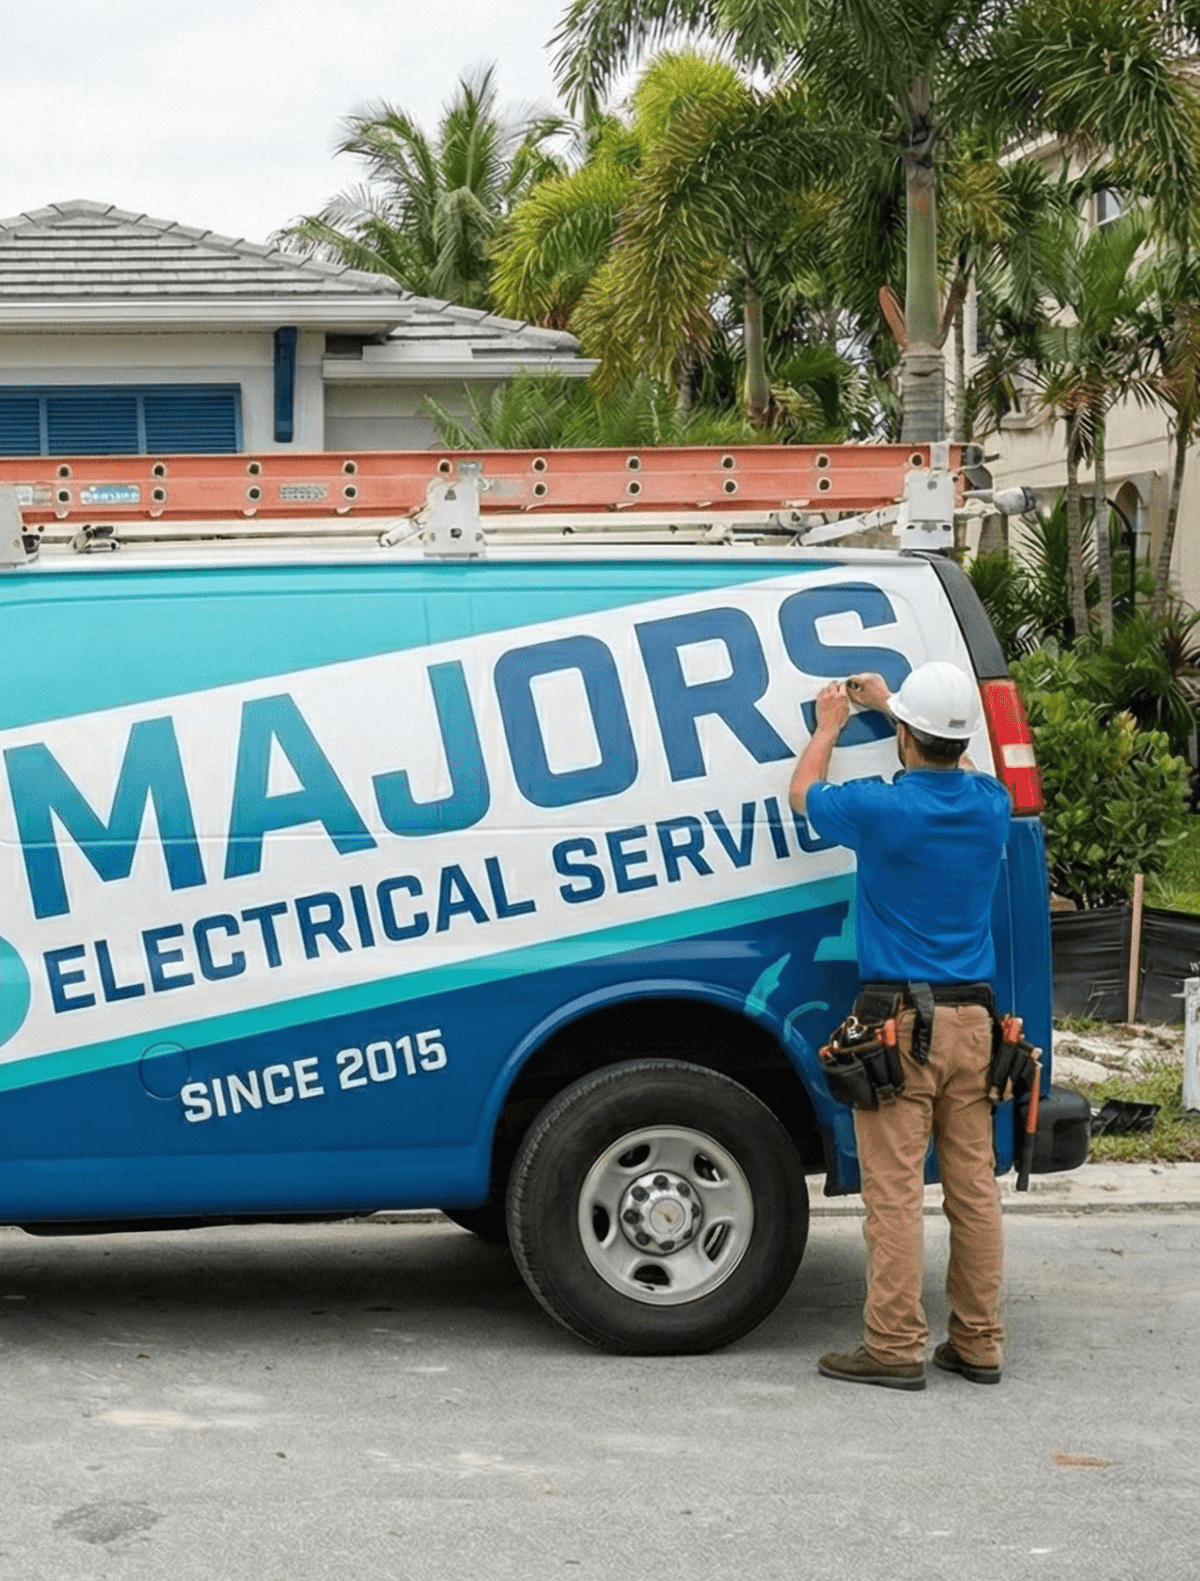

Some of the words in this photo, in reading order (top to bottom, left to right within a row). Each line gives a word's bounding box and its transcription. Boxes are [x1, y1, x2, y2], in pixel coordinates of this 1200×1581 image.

[3, 581, 913, 920] MAJORS
[43, 856, 537, 1014] ELECTRICAL
[552, 769, 906, 904] SERVI
[180, 1056, 325, 1123] SINCE
[335, 1028, 448, 1090] 2015
